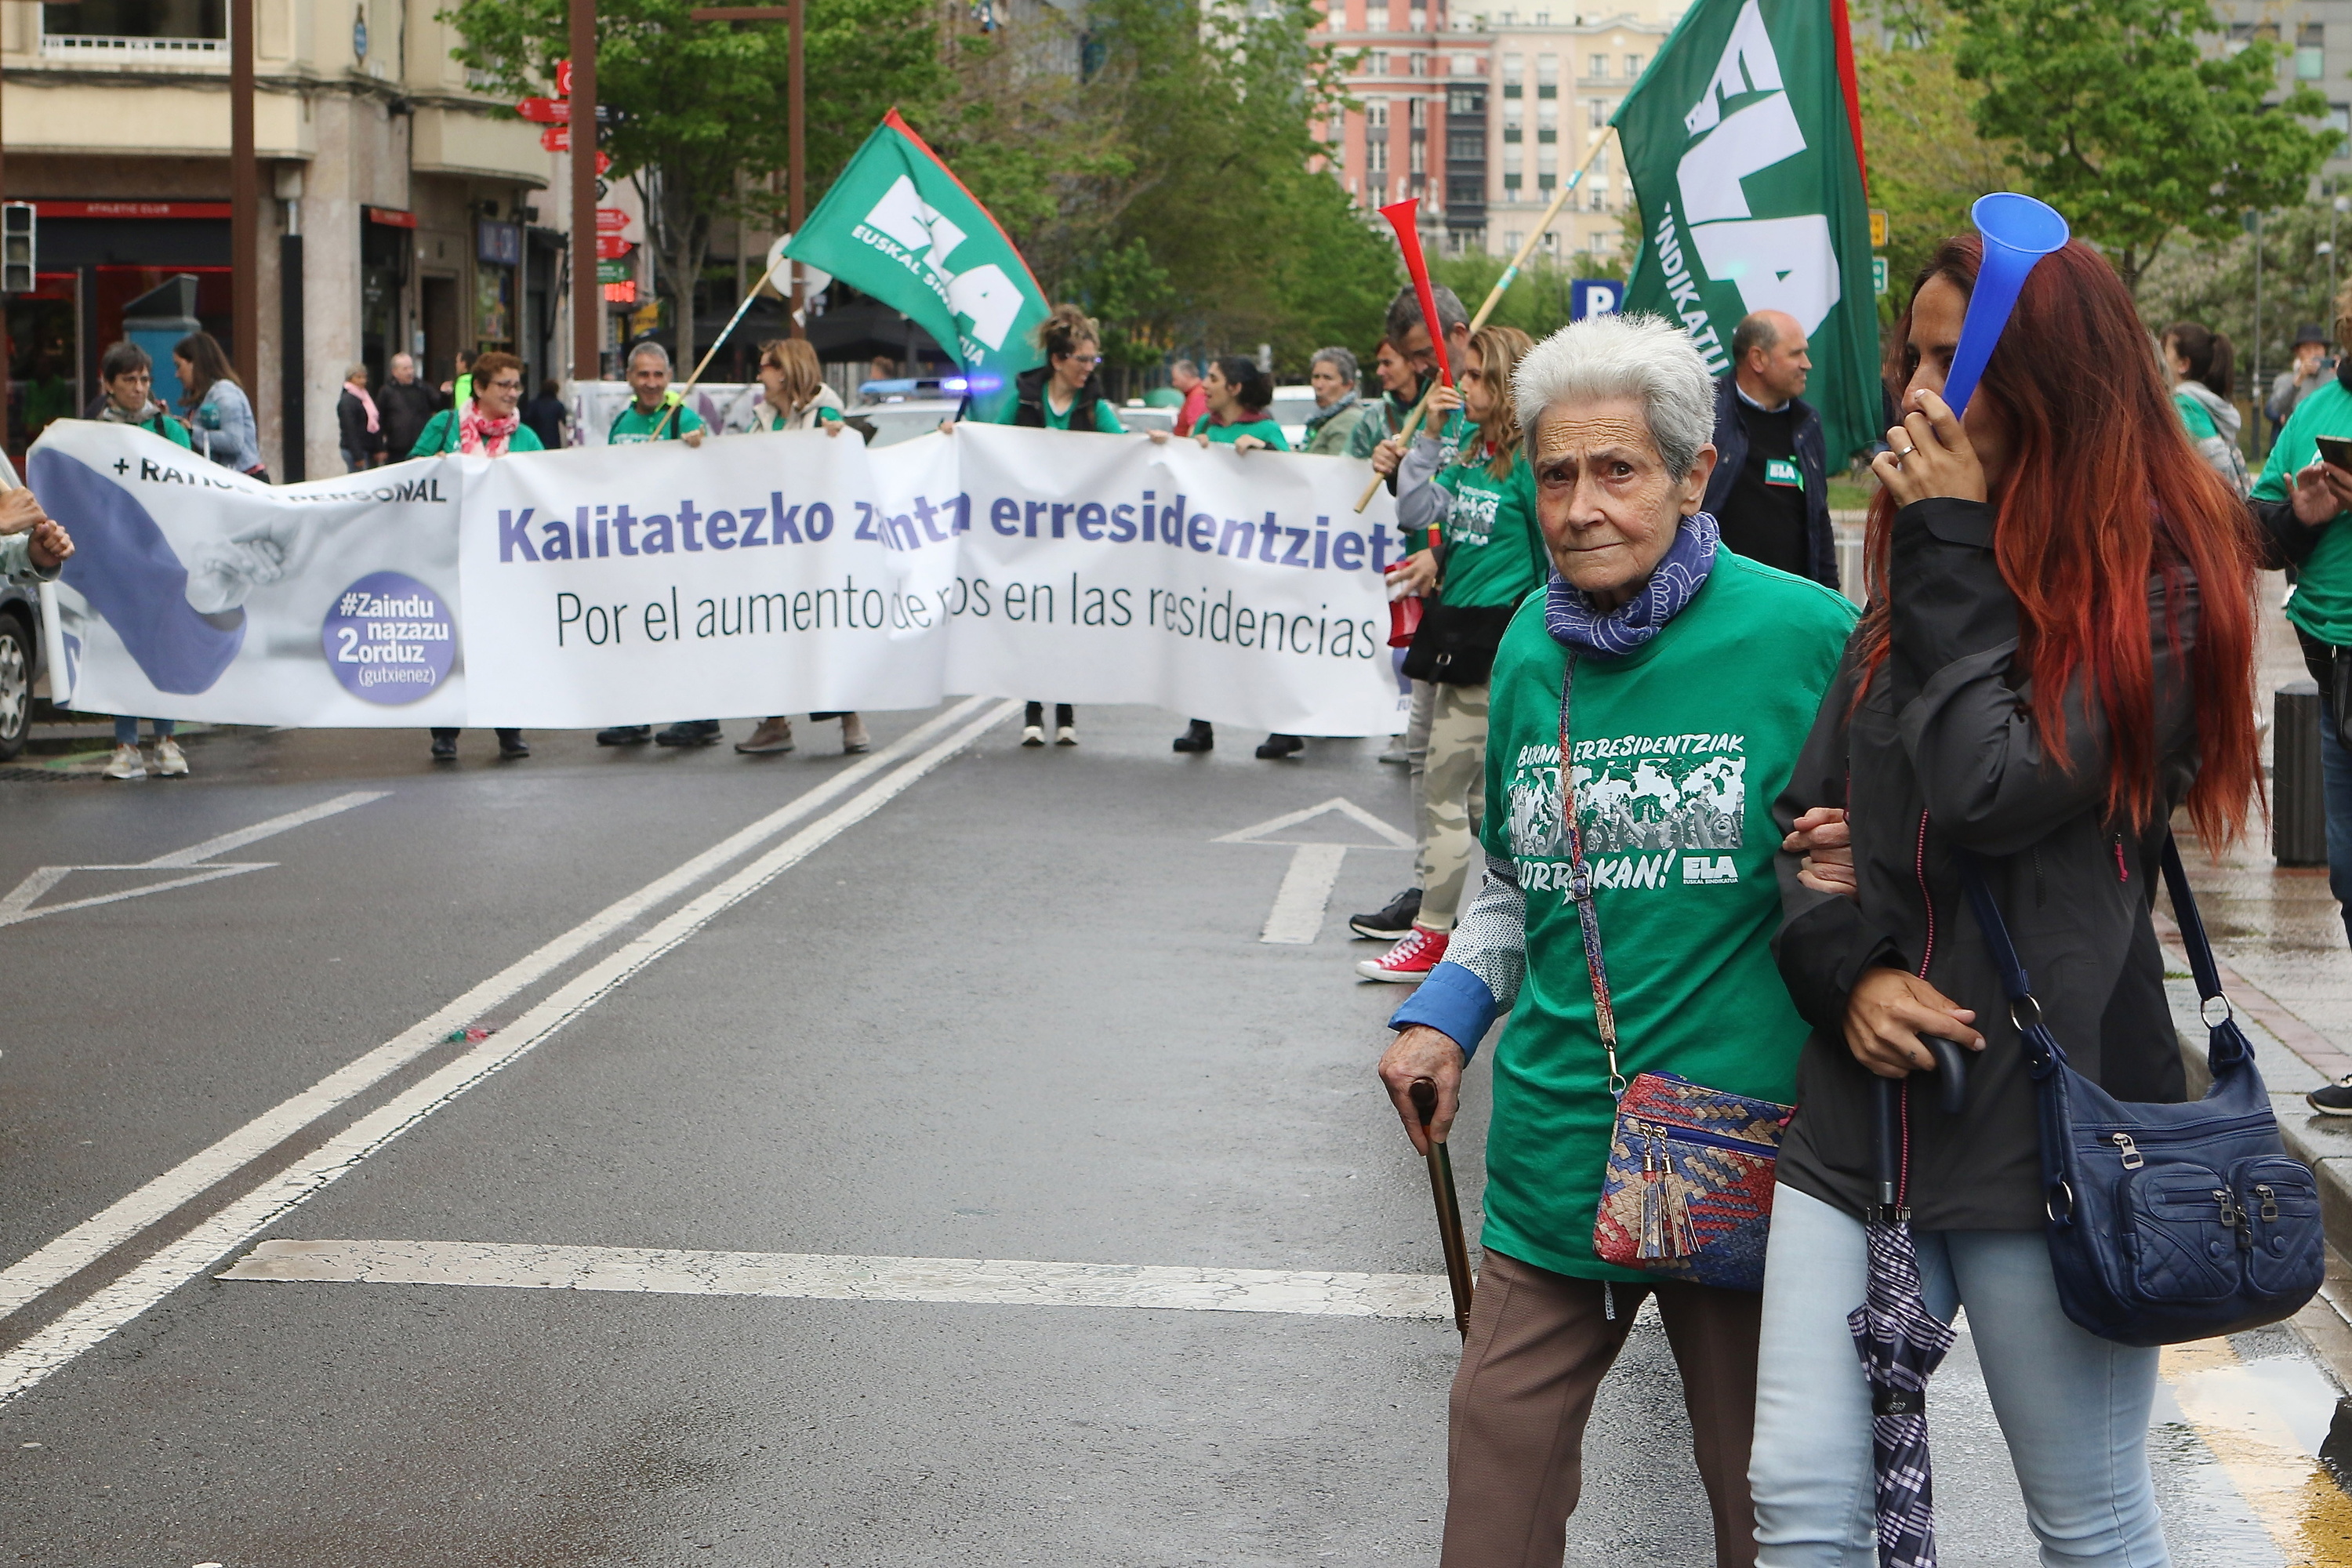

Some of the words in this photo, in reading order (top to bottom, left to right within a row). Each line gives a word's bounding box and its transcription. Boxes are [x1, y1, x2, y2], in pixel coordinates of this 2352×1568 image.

[851, 224, 921, 275] EUSKAL
[1586, 285, 1615, 324] P
[1769, 463, 1796, 479] ELA
[497, 491, 834, 564] Kalitatezko
[340, 593, 434, 619] #Zaindu
[556, 591, 628, 647] Por
[644, 586, 679, 641] el
[696, 575, 884, 639] aumento
[891, 579, 931, 629] de
[1004, 582, 1054, 623] en
[1072, 572, 1132, 626] las
[1149, 587, 1375, 659] residencias
[367, 622, 449, 641] nazazu
[358, 641, 426, 663] orduz
[358, 666, 436, 688] (gutxienez)
[1573, 733, 1744, 764] ERRESIDENTZIAK
[1682, 855, 1739, 879] ELA
